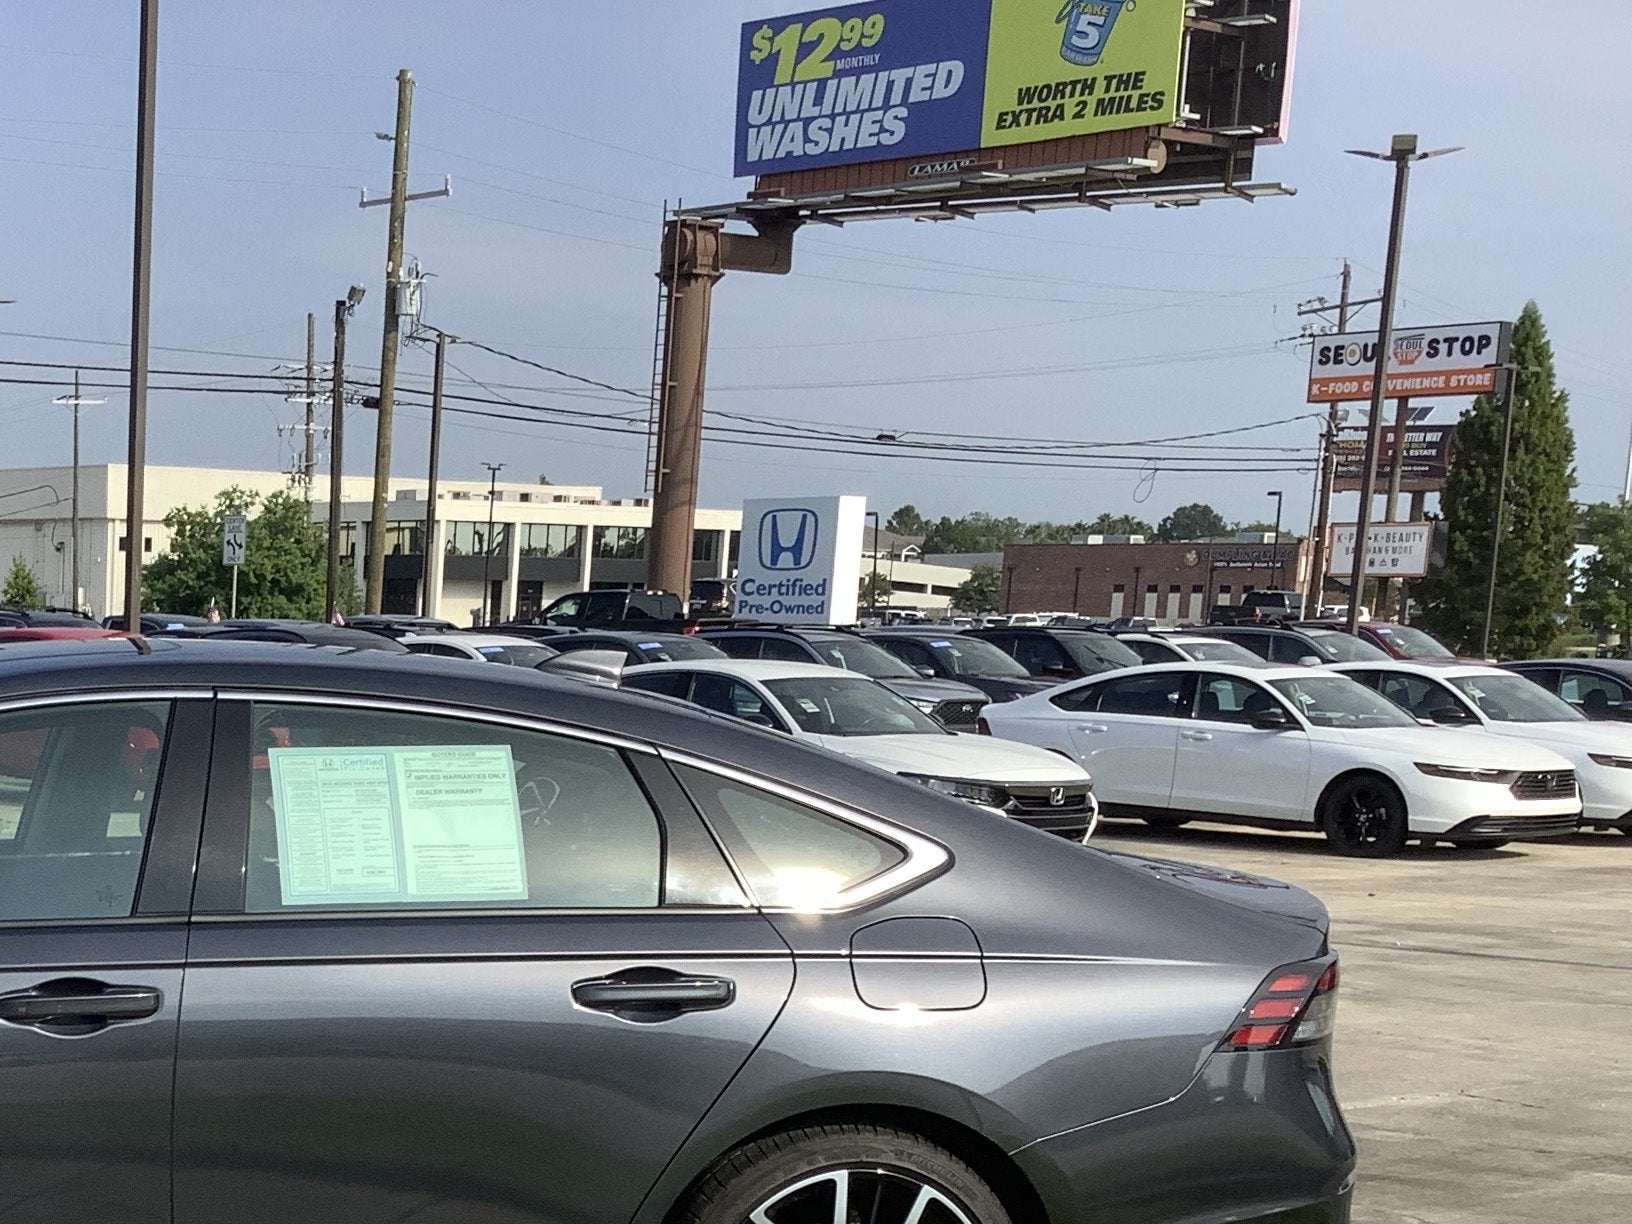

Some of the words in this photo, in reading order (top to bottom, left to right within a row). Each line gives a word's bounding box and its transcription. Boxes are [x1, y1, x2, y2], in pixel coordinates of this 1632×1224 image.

[1079, 3, 1111, 17] TAKE
[1071, 14, 1105, 49] 5
[836, 53, 881, 70] MONTHLY
[748, 60, 966, 126] UNLIMITED
[1017, 77, 1098, 107] WORTH
[1103, 71, 1147, 94] THE
[995, 101, 1066, 131] EXTRA
[1072, 101, 1089, 120] 2
[1093, 91, 1166, 117] MILES
[747, 107, 909, 163] WASHES
[1318, 342, 1391, 366] SEOU
[1396, 351, 1419, 361] STOP
[1425, 334, 1492, 359] STOP
[1311, 381, 1359, 395] K-FOOD
[1450, 373, 1491, 387] STORE
[1373, 532, 1424, 544] K-BEAUTY
[740, 578, 827, 597] Certified
[738, 600, 825, 615] Pre-Owned
[342, 757, 384, 766] Certified
